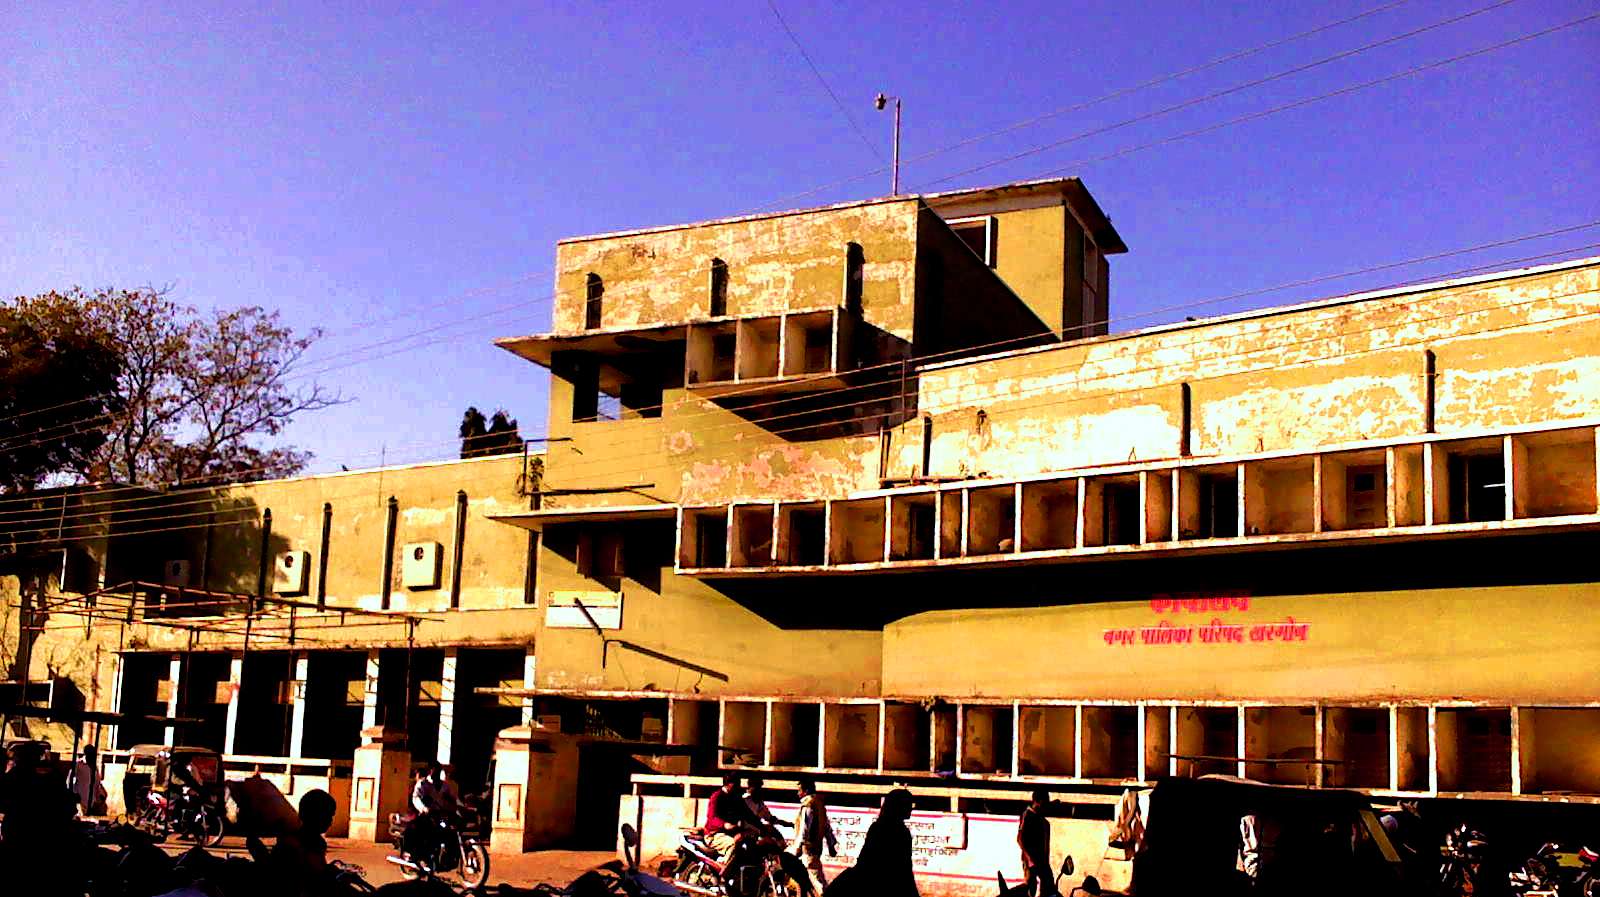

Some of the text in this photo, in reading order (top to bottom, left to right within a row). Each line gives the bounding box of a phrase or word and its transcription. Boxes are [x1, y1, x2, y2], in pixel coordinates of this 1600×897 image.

[1103, 628, 1135, 646] नगर
[1140, 620, 1192, 645] पालिका
[1249, 615, 1309, 641] खरगोन
